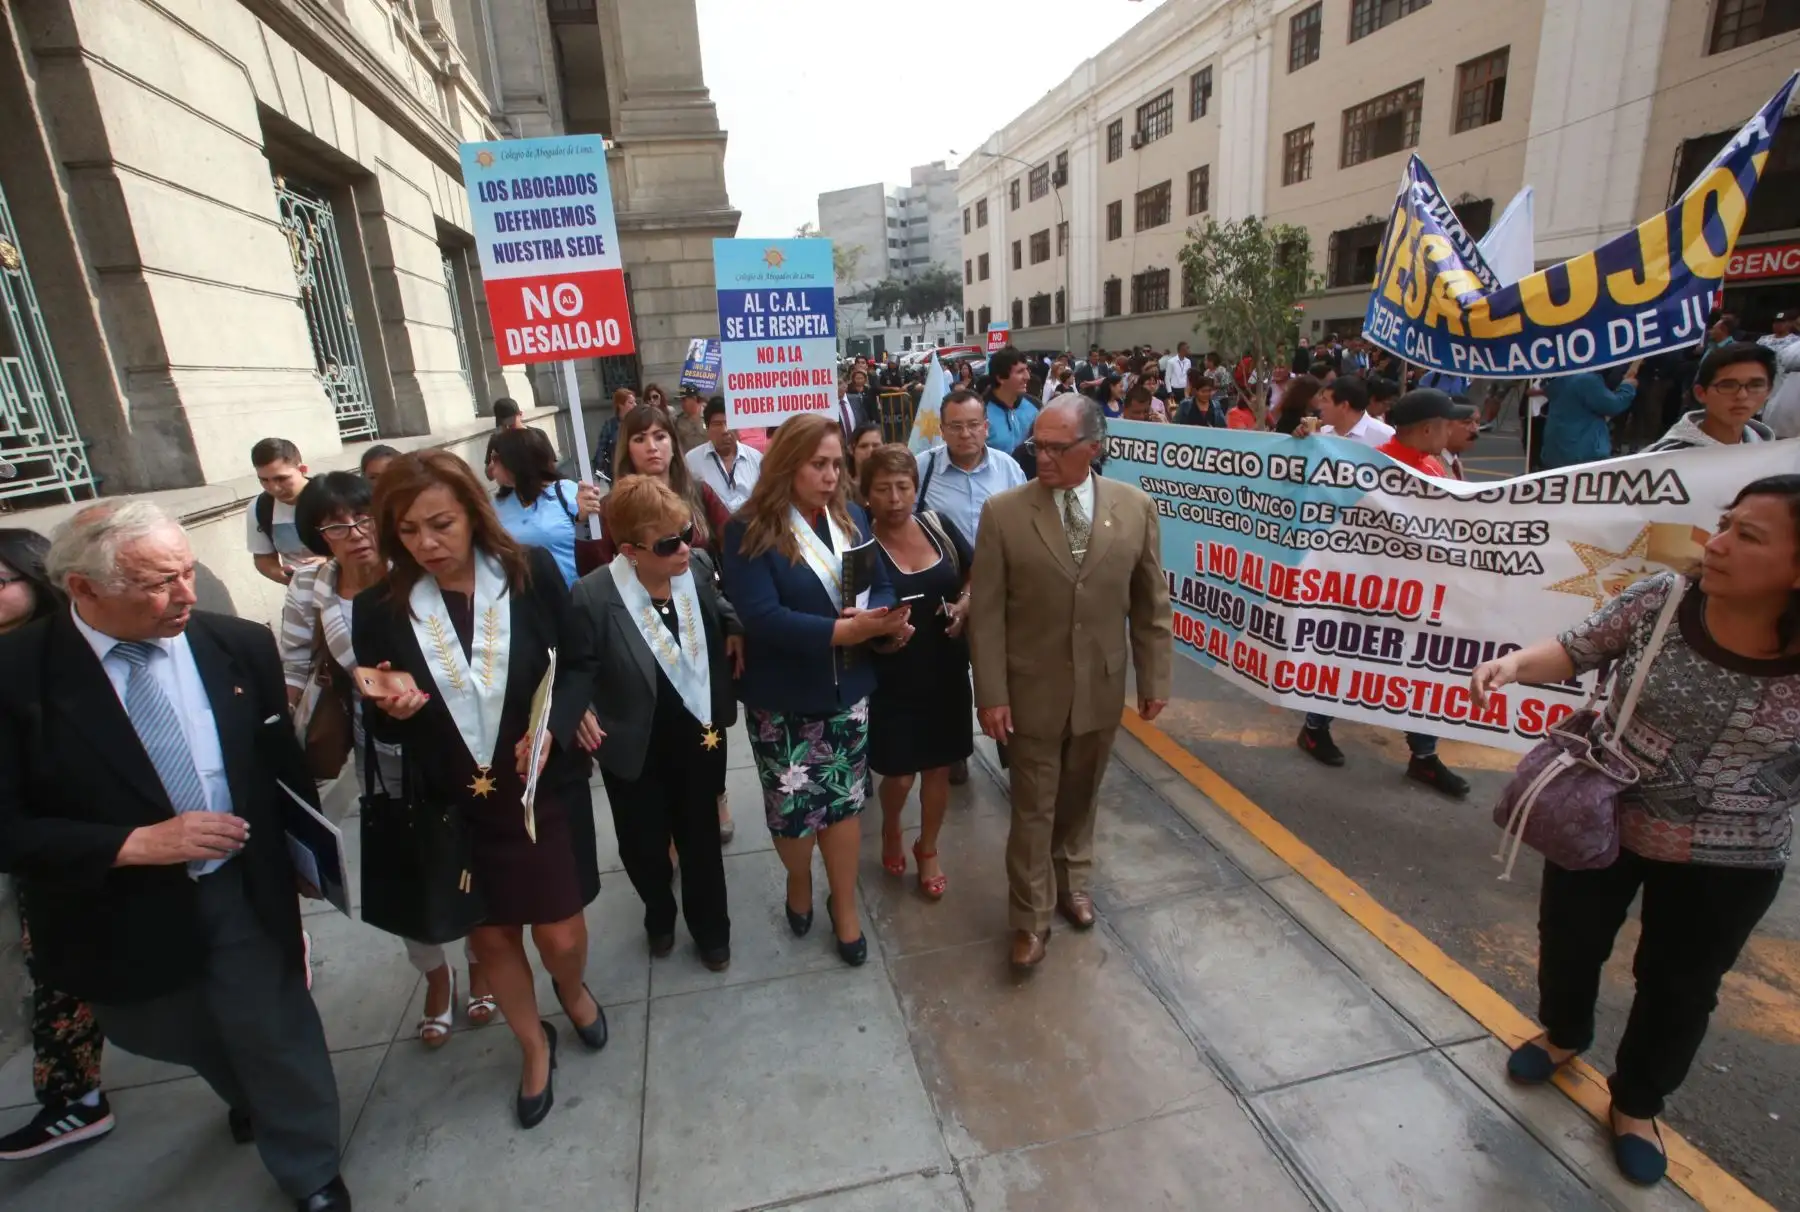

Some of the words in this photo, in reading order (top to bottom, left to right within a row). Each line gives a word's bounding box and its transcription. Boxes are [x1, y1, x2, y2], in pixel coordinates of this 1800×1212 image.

[501, 147, 524, 162] Colegio
[534, 145, 566, 160] Abogados
[477, 179, 509, 203] LOS
[512, 172, 598, 200] ABOGADOS
[494, 204, 597, 233] DEFENDEMOS
[492, 238, 565, 264] NUESTRA
[566, 234, 605, 257] SEDE
[521, 282, 584, 320] NO
[562, 295, 575, 305] AL
[744, 292, 765, 313] AL
[769, 291, 811, 313] C.A.L
[505, 318, 621, 356] DESALOJO
[726, 316, 745, 339] SE
[748, 315, 765, 338] LE
[769, 314, 830, 337] RESPETA
[993, 331, 1003, 342] NO
[1369, 298, 1403, 347] SEDE
[1405, 326, 1442, 365] CAL
[1450, 328, 1596, 372] PALACIO
[1607, 308, 1662, 356] DE
[757, 346, 775, 364] NO
[777, 345, 786, 363] A
[788, 345, 803, 363] LA
[728, 367, 809, 391] CORRUPCIÓN
[811, 368, 833, 386] DEL
[734, 396, 775, 415] PODER
[777, 392, 831, 412] JUDICIAL
[1161, 442, 1262, 479] COLEGIO
[1268, 453, 1307, 484] DE
[1308, 457, 1505, 502] ABOGADS
[1509, 474, 1566, 504] DE
[1572, 467, 1691, 505] LIMA
[1139, 475, 1233, 506] SINDICATO
[1236, 485, 1296, 520] ÚNICO
[1301, 502, 1334, 524] DE
[1339, 505, 1550, 546] TRABAJADORES
[1154, 497, 1177, 518] EL
[1178, 503, 1253, 536] COLEGIO
[1255, 519, 1281, 544] DE
[1281, 526, 1422, 562] ABOGADOS
[1426, 545, 1466, 567] DE
[1470, 549, 1545, 575] LIMA
[1239, 551, 1265, 597] AL
[1267, 562, 1423, 622] DESALOJO
[1162, 569, 1179, 602] L
[1180, 576, 1247, 631] ABUSO
[1247, 603, 1288, 650] DEL
[1292, 617, 1405, 666] PODER
[1206, 627, 1230, 667] AL
[1231, 640, 1269, 688] CAL
[1271, 660, 1341, 704] CON
